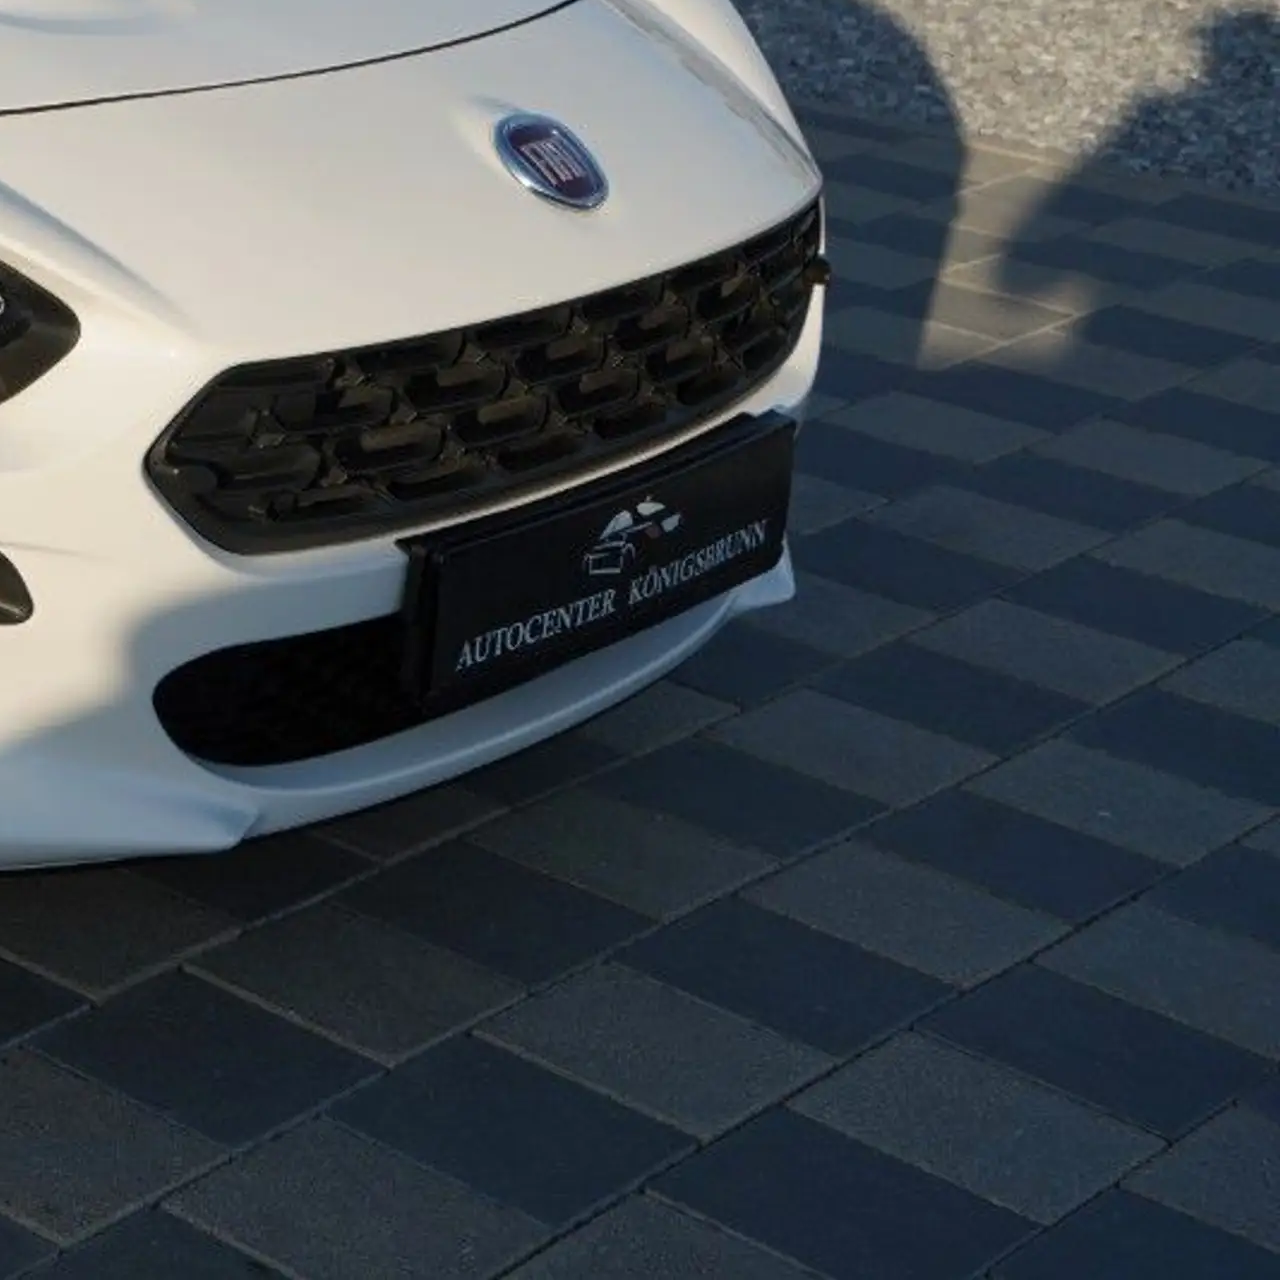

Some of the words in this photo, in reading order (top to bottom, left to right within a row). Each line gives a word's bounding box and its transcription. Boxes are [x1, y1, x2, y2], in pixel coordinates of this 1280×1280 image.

[519, 139, 586, 187] FIAT
[456, 588, 616, 671] AUTOCENTER
[628, 519, 767, 606] KÖNIGSBRUNN
